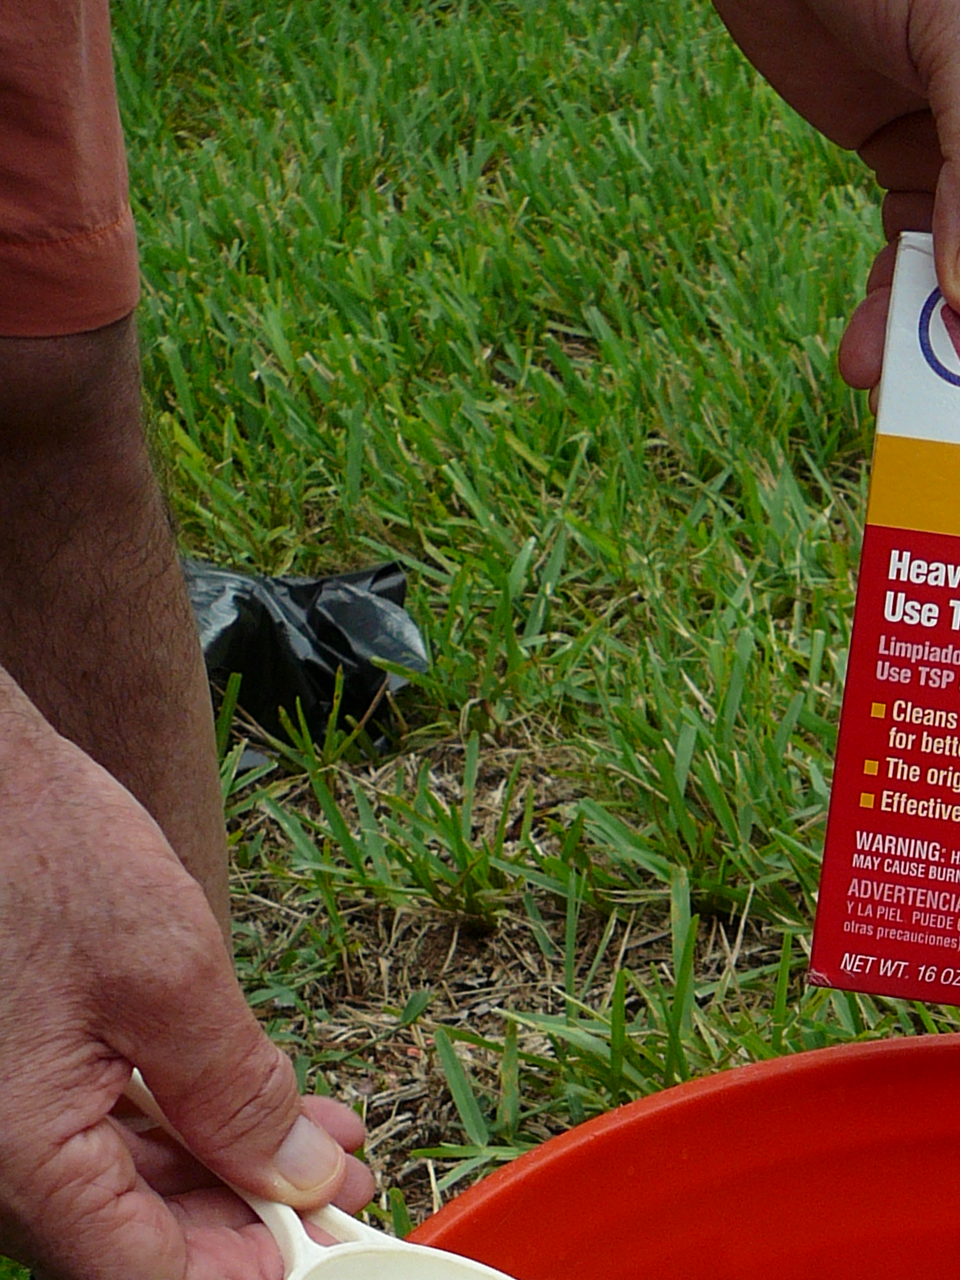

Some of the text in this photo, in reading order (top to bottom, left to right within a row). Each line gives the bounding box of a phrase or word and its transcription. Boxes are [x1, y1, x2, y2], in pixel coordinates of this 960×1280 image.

[883, 590, 940, 628] Use
[876, 660, 912, 684] Use
[918, 666, 955, 689] TSP
[892, 699, 958, 729] Cleans
[888, 726, 917, 750] for
[885, 757, 921, 782] The
[855, 830, 946, 863] WARNING:
[851, 852, 883, 872] MAY
[883, 859, 926, 878] CAUSE
[843, 920, 874, 936] otras
[846, 901, 855, 914] Y
[857, 903, 873, 918] LA
[911, 911, 954, 930] PUEDE
[840, 952, 877, 974] NET
[879, 958, 909, 979] WT.
[918, 964, 938, 983] 16
